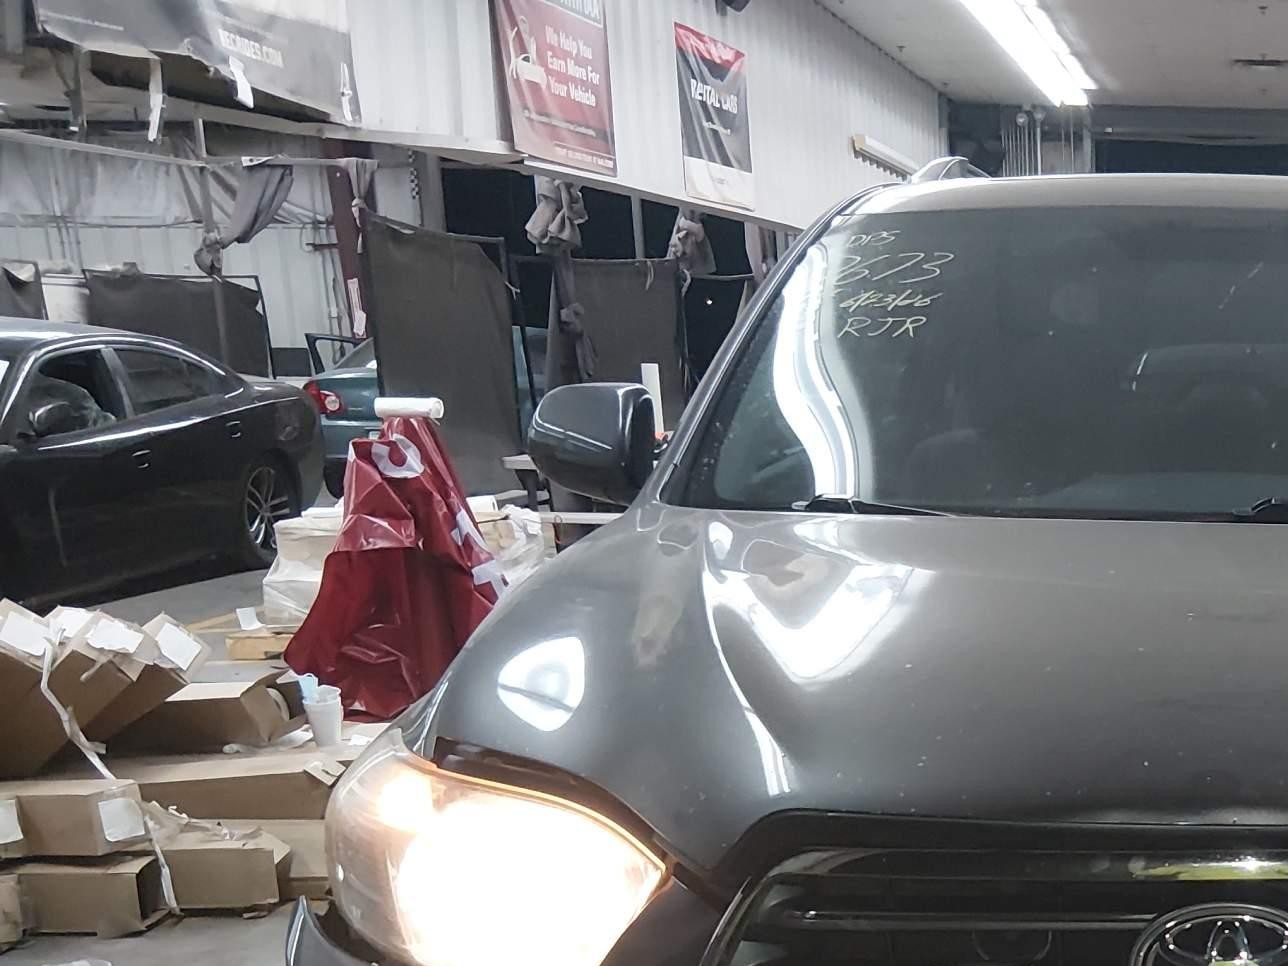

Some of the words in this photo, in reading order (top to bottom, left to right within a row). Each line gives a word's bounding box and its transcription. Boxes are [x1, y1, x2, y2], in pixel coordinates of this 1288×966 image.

[560, 31, 577, 57] Help
[578, 39, 592, 60] You
[547, 51, 566, 73] Earn
[567, 58, 587, 81] More
[588, 65, 600, 85] For
[548, 75, 567, 97] Your
[568, 81, 596, 107] Vehicle
[720, 94, 738, 114] CARS
